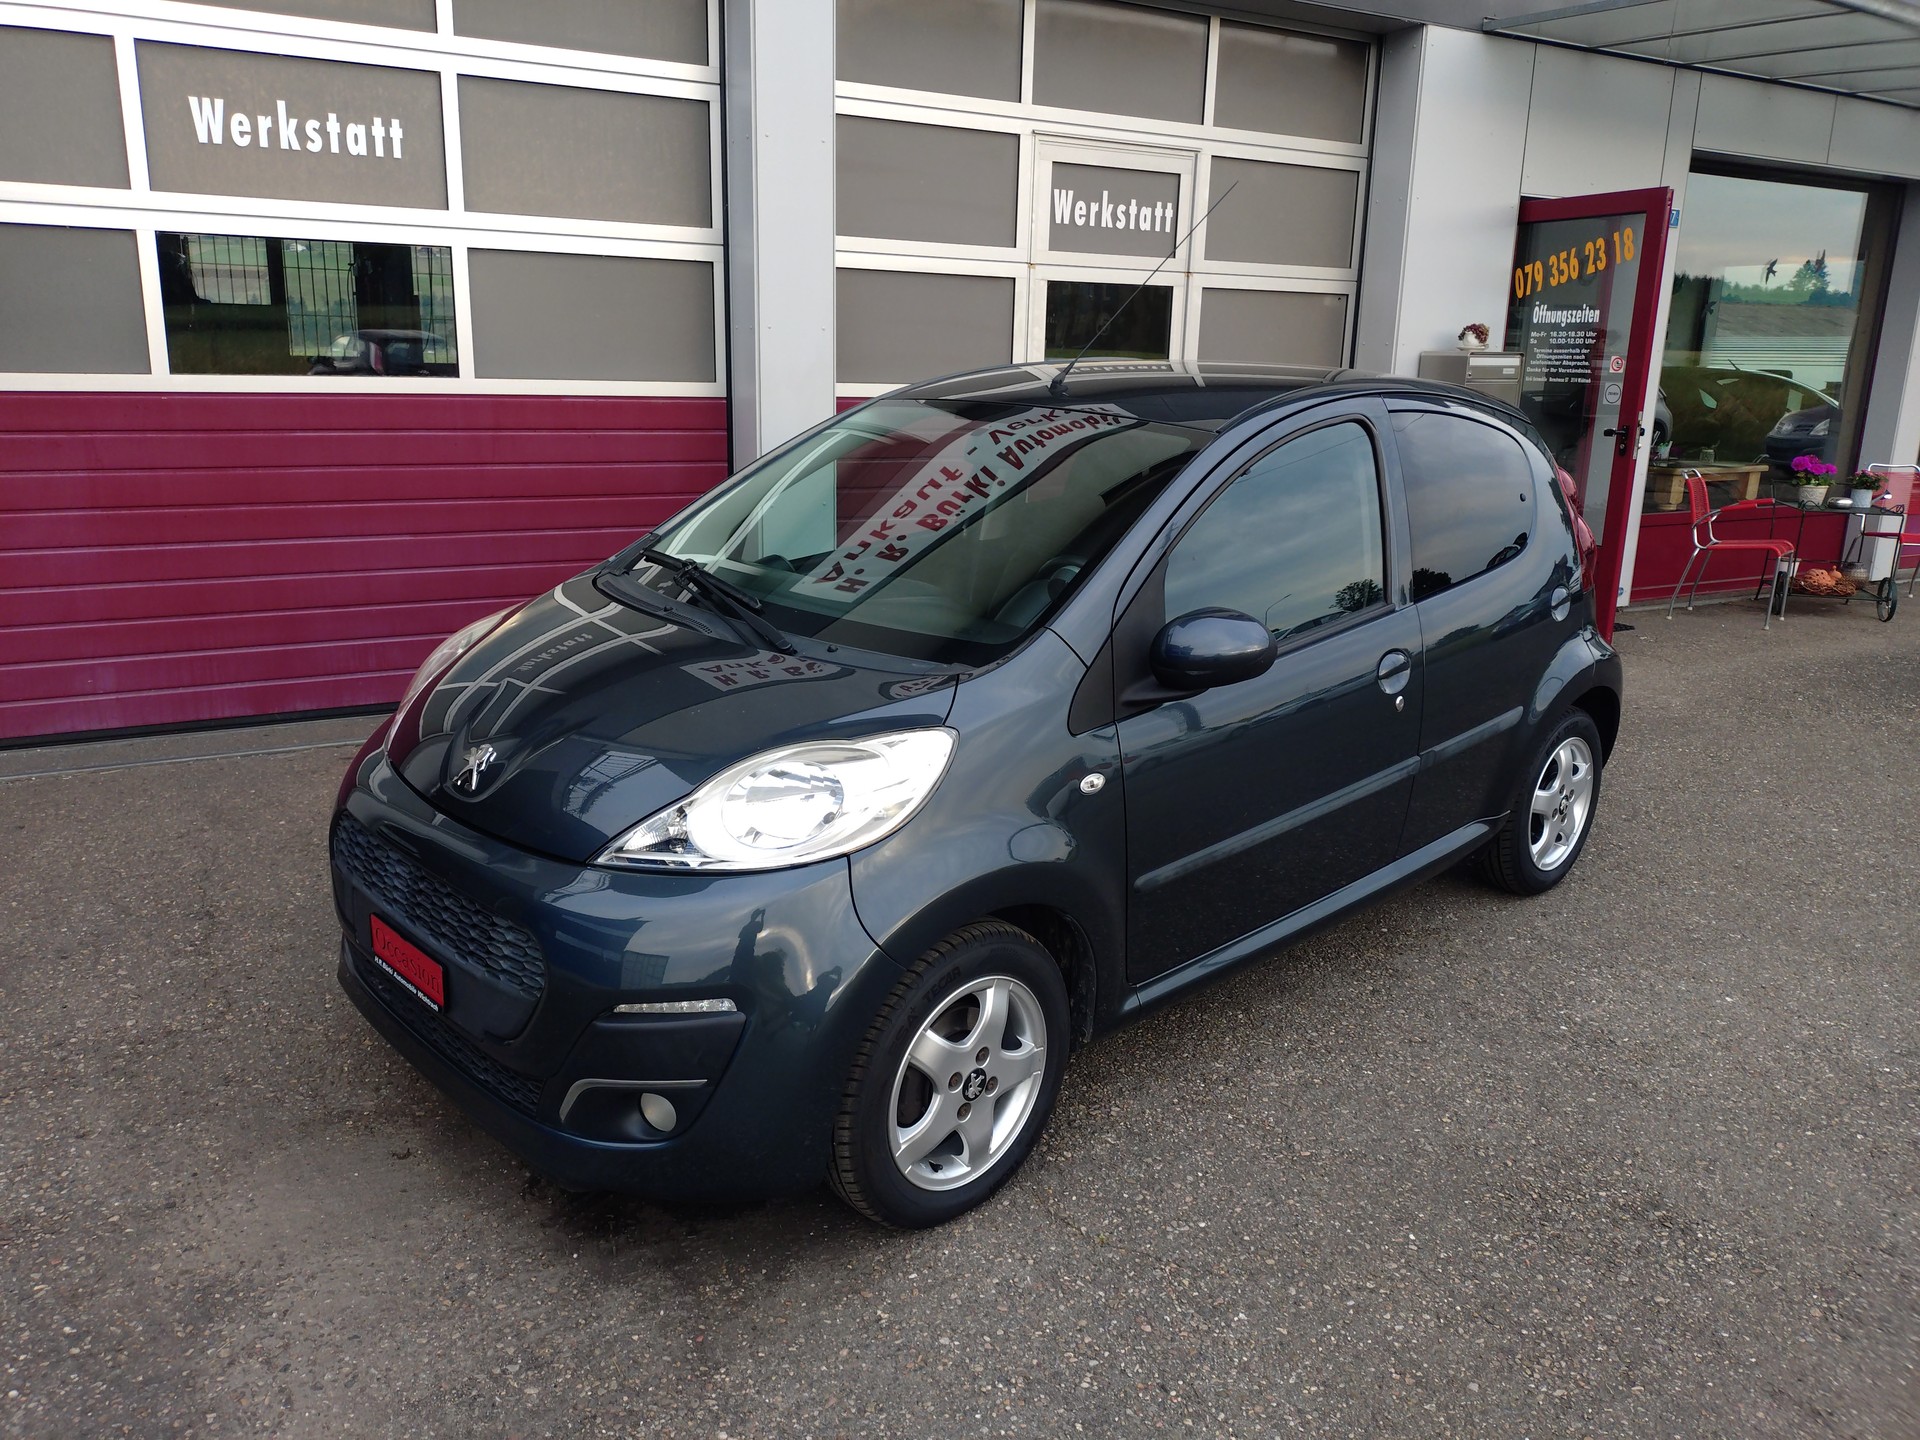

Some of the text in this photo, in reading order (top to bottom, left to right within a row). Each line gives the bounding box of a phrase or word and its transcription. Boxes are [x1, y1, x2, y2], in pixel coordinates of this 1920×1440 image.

[187, 96, 403, 158] Werkstatt
[1053, 188, 1173, 233] Werkstatt
[1515, 227, 1635, 299] 079 356 23 18
[1533, 301, 1600, 327] Öffnungszeiten
